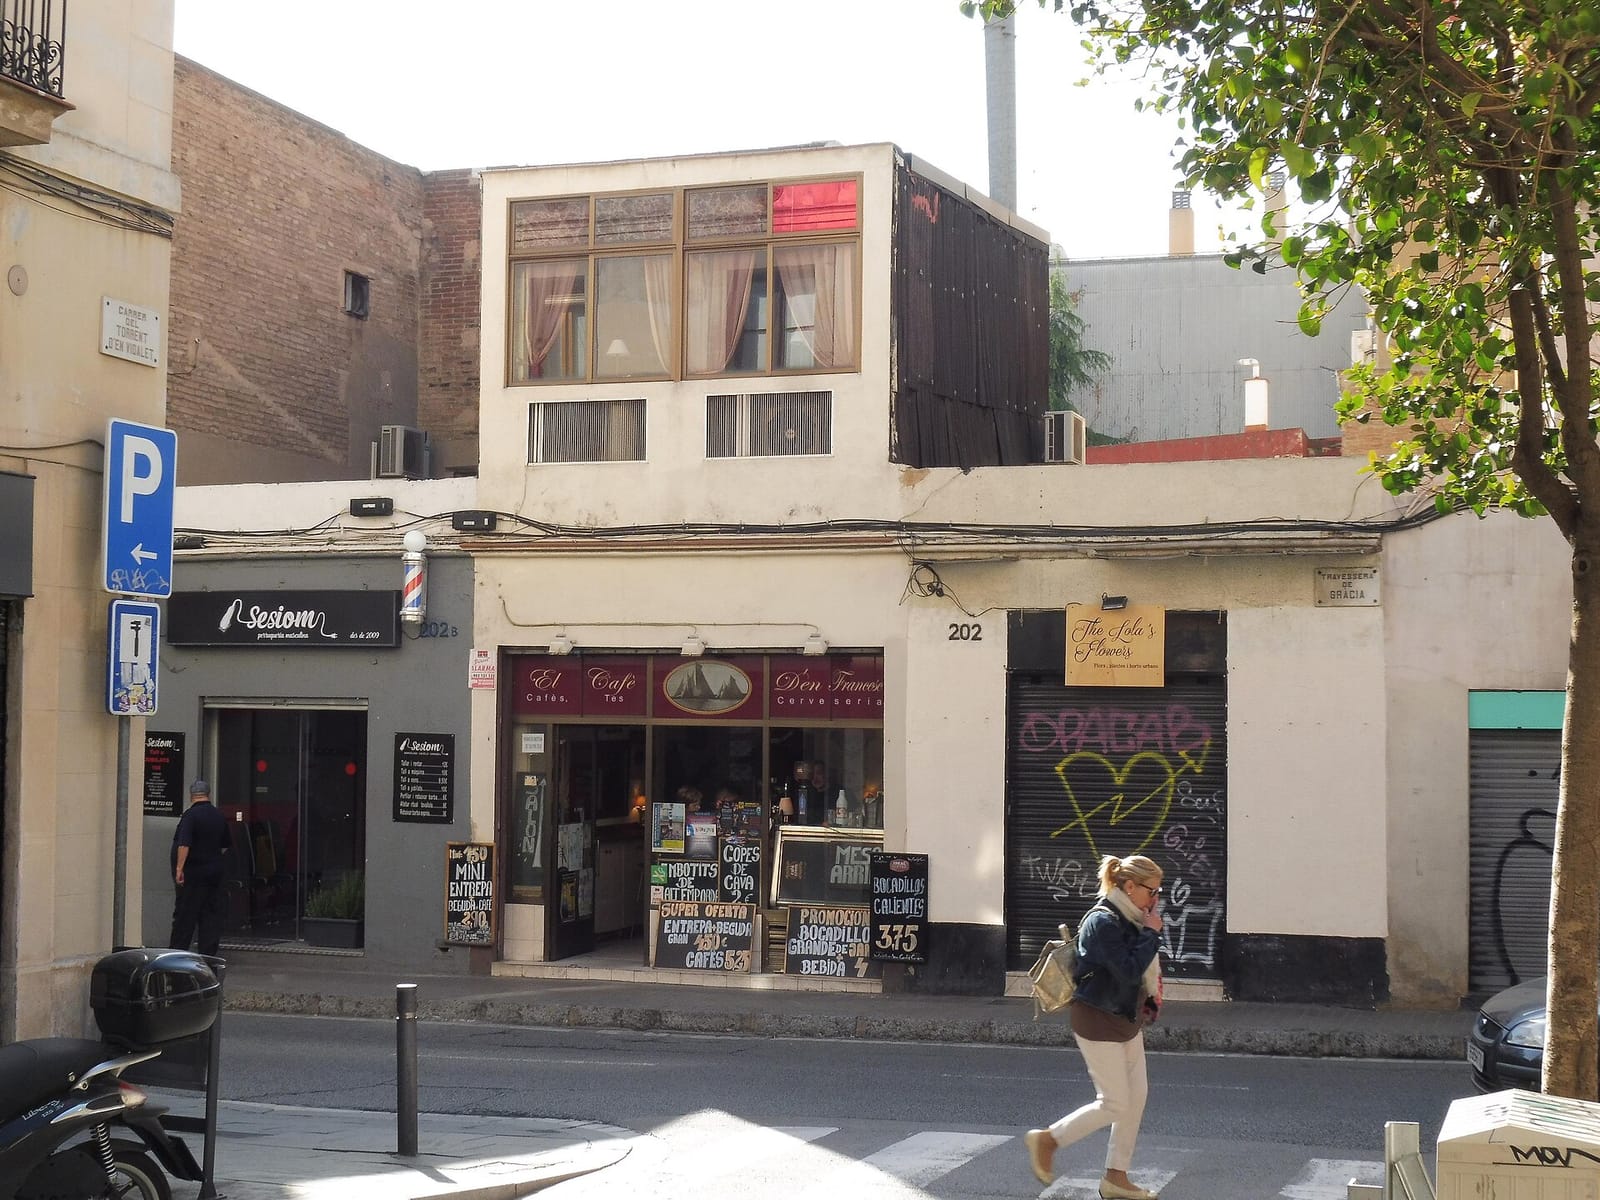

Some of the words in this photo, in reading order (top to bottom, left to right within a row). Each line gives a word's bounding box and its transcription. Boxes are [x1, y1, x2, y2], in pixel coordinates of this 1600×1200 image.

[118, 305, 147, 321] CARRER
[125, 317, 140, 329] DEL
[116, 324, 148, 345] TORRENT
[121, 434, 162, 524] P
[1321, 573, 1374, 581] TRAVESSERA
[246, 604, 317, 629] Sesiom
[366, 631, 380, 640] 2009
[948, 623, 983, 641] 202
[1072, 616, 1103, 643] The
[1074, 637, 1133, 663] Flowers
[529, 668, 562, 690] El
[147, 737, 173, 748] Sesiom
[411, 740, 441, 752] Sesiom
[723, 844, 760, 863] COPES
[454, 862, 486, 881] MINI
[661, 862, 719, 879] MBOTITS
[730, 862, 750, 876] DE
[830, 864, 871, 885] ARRI
[449, 880, 493, 897] ENTREPA
[675, 876, 695, 889] DE
[723, 874, 754, 890] CAVA
[873, 875, 926, 896] BOCADILLOS
[731, 889, 742, 903] 2
[661, 902, 699, 918] SUPER
[704, 904, 748, 919] OFERTA
[873, 896, 925, 919] CALIENTES
[667, 933, 689, 945] GRAN
[797, 925, 871, 944] BOCADILLO
[787, 938, 837, 957] GRANDE
[835, 943, 849, 955] DE
[799, 958, 846, 977] BEBIDA
